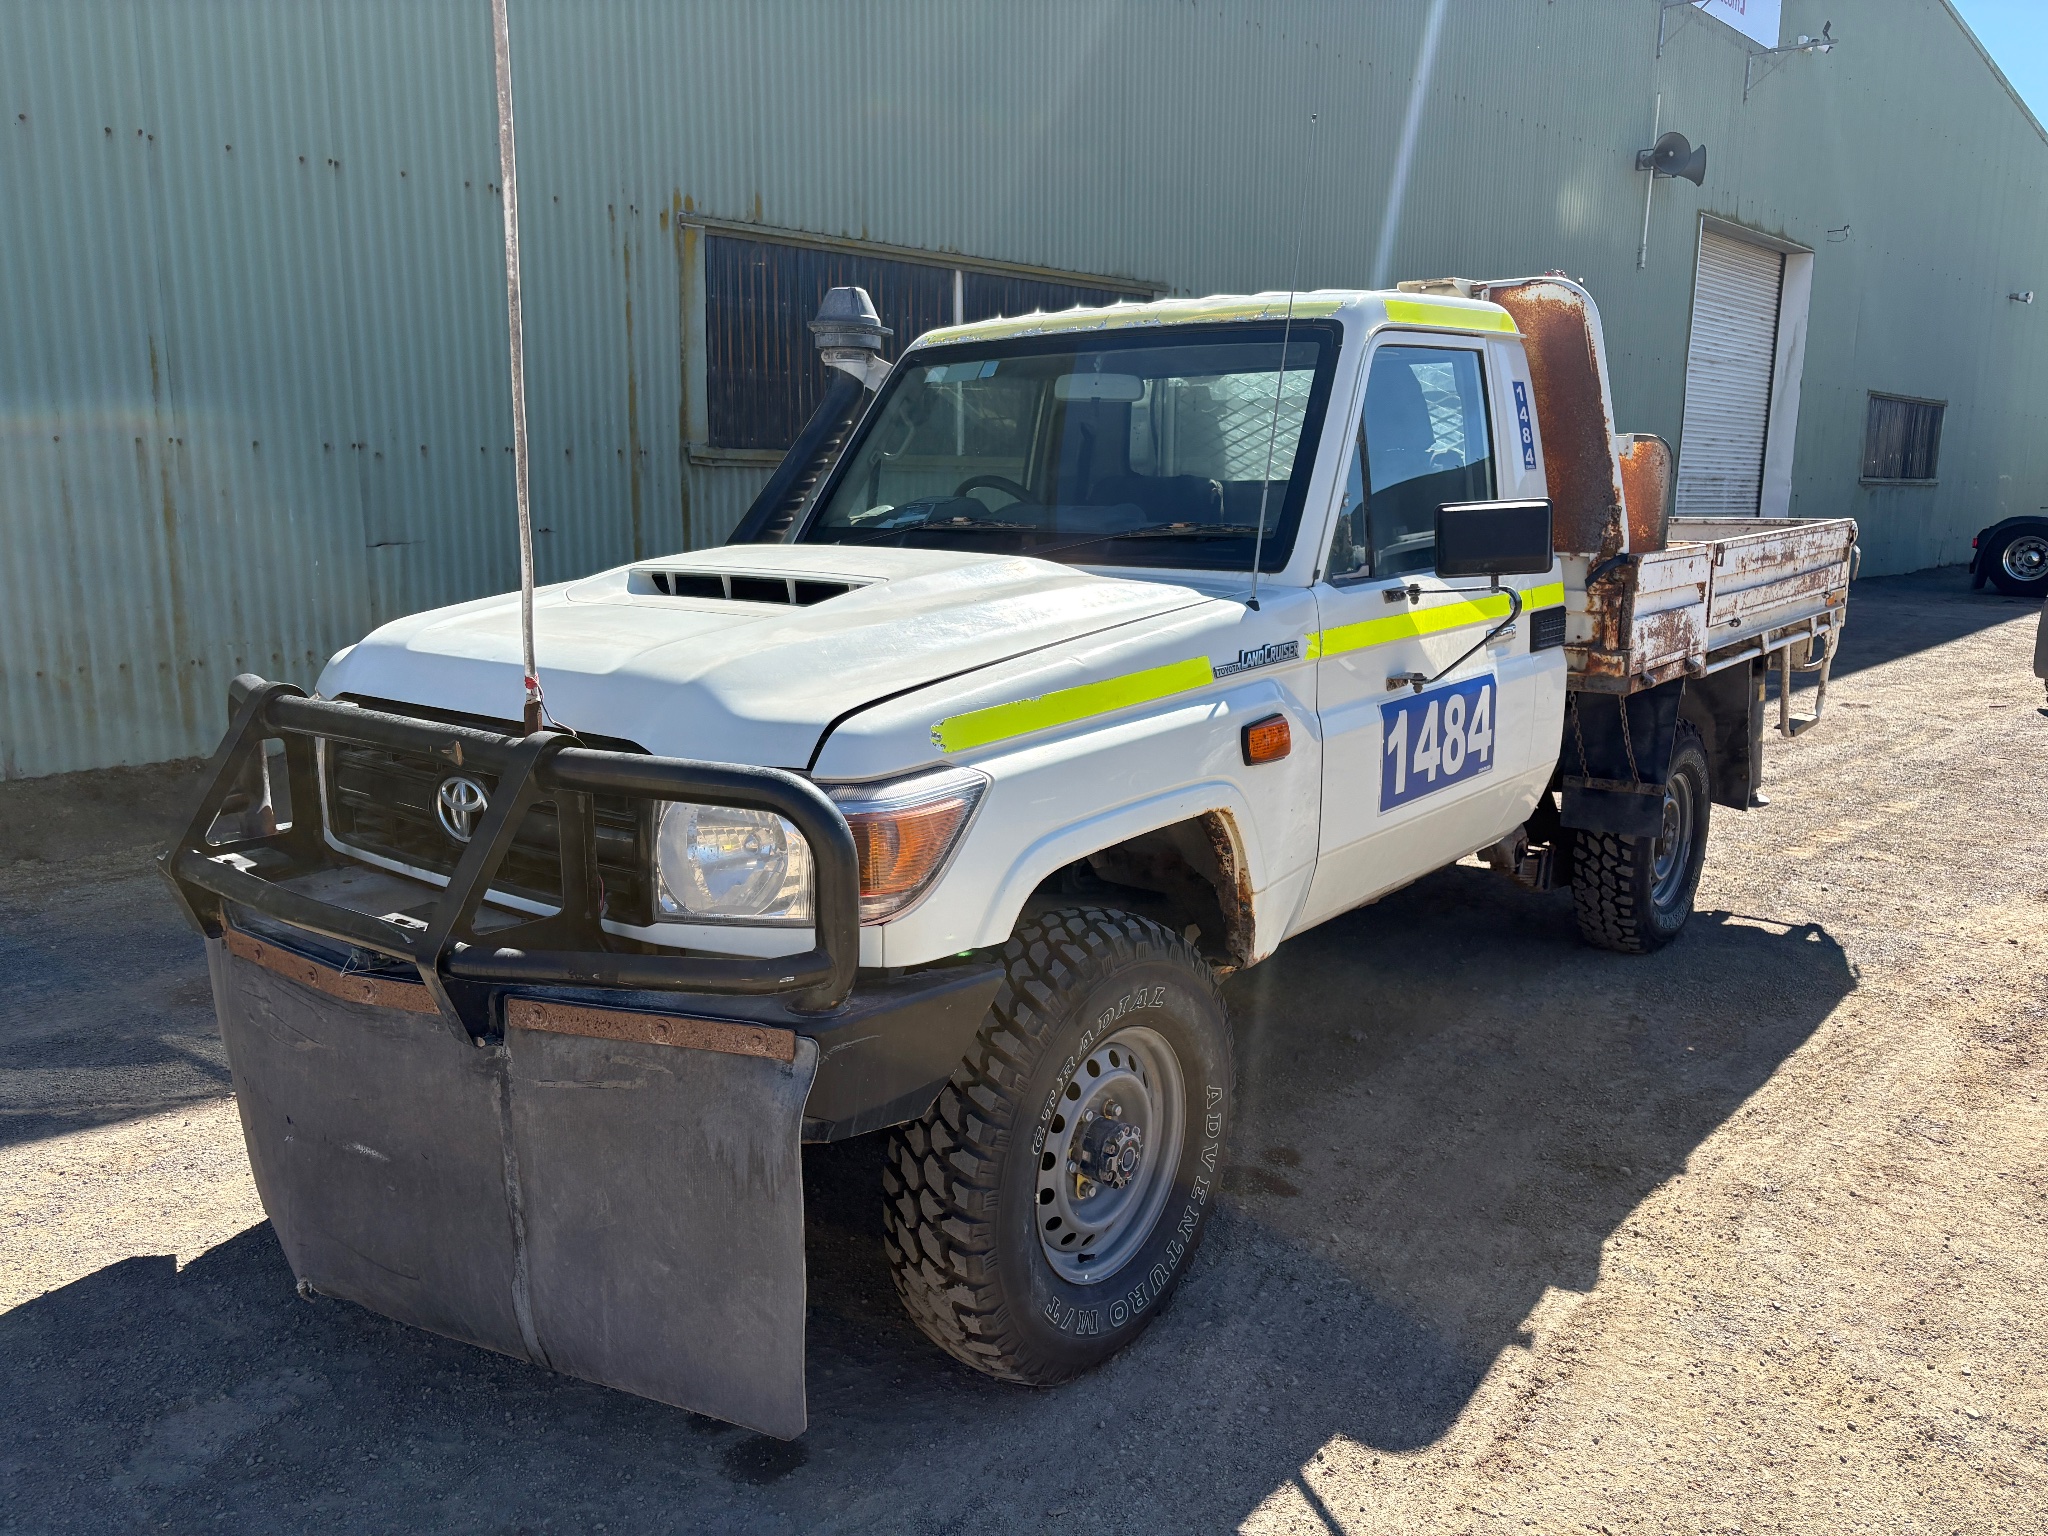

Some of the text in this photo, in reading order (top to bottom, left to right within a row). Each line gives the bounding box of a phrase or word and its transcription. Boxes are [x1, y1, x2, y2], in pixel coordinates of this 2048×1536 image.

[1515, 385, 1534, 465] 1484
[1213, 663, 1240, 677] TOYOTA
[1387, 684, 1492, 795] 1484
[1044, 1084, 1223, 1335] ADVENTURO M/T
